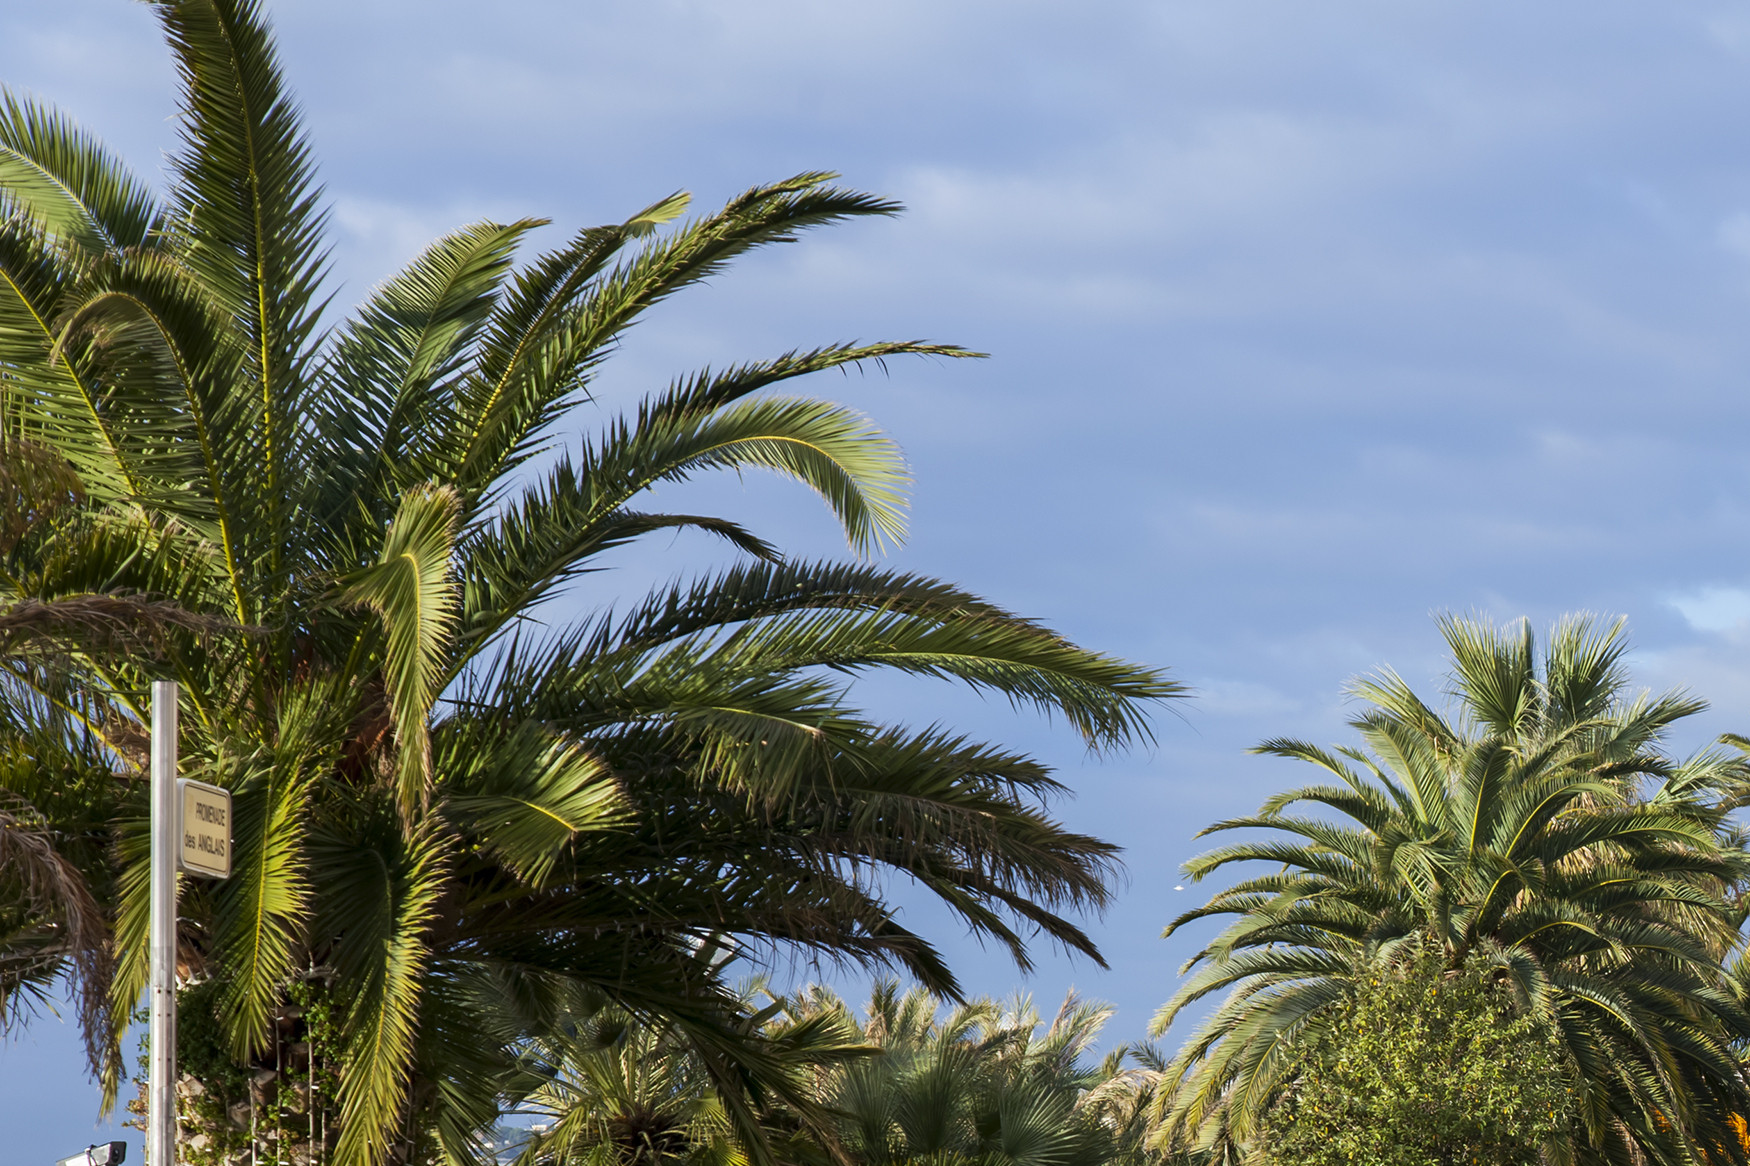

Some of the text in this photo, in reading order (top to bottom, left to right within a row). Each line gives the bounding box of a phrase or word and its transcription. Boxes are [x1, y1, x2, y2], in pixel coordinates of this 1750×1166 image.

[195, 802, 226, 827] PROMENADE
[184, 830, 225, 858] des ANGLAIS
